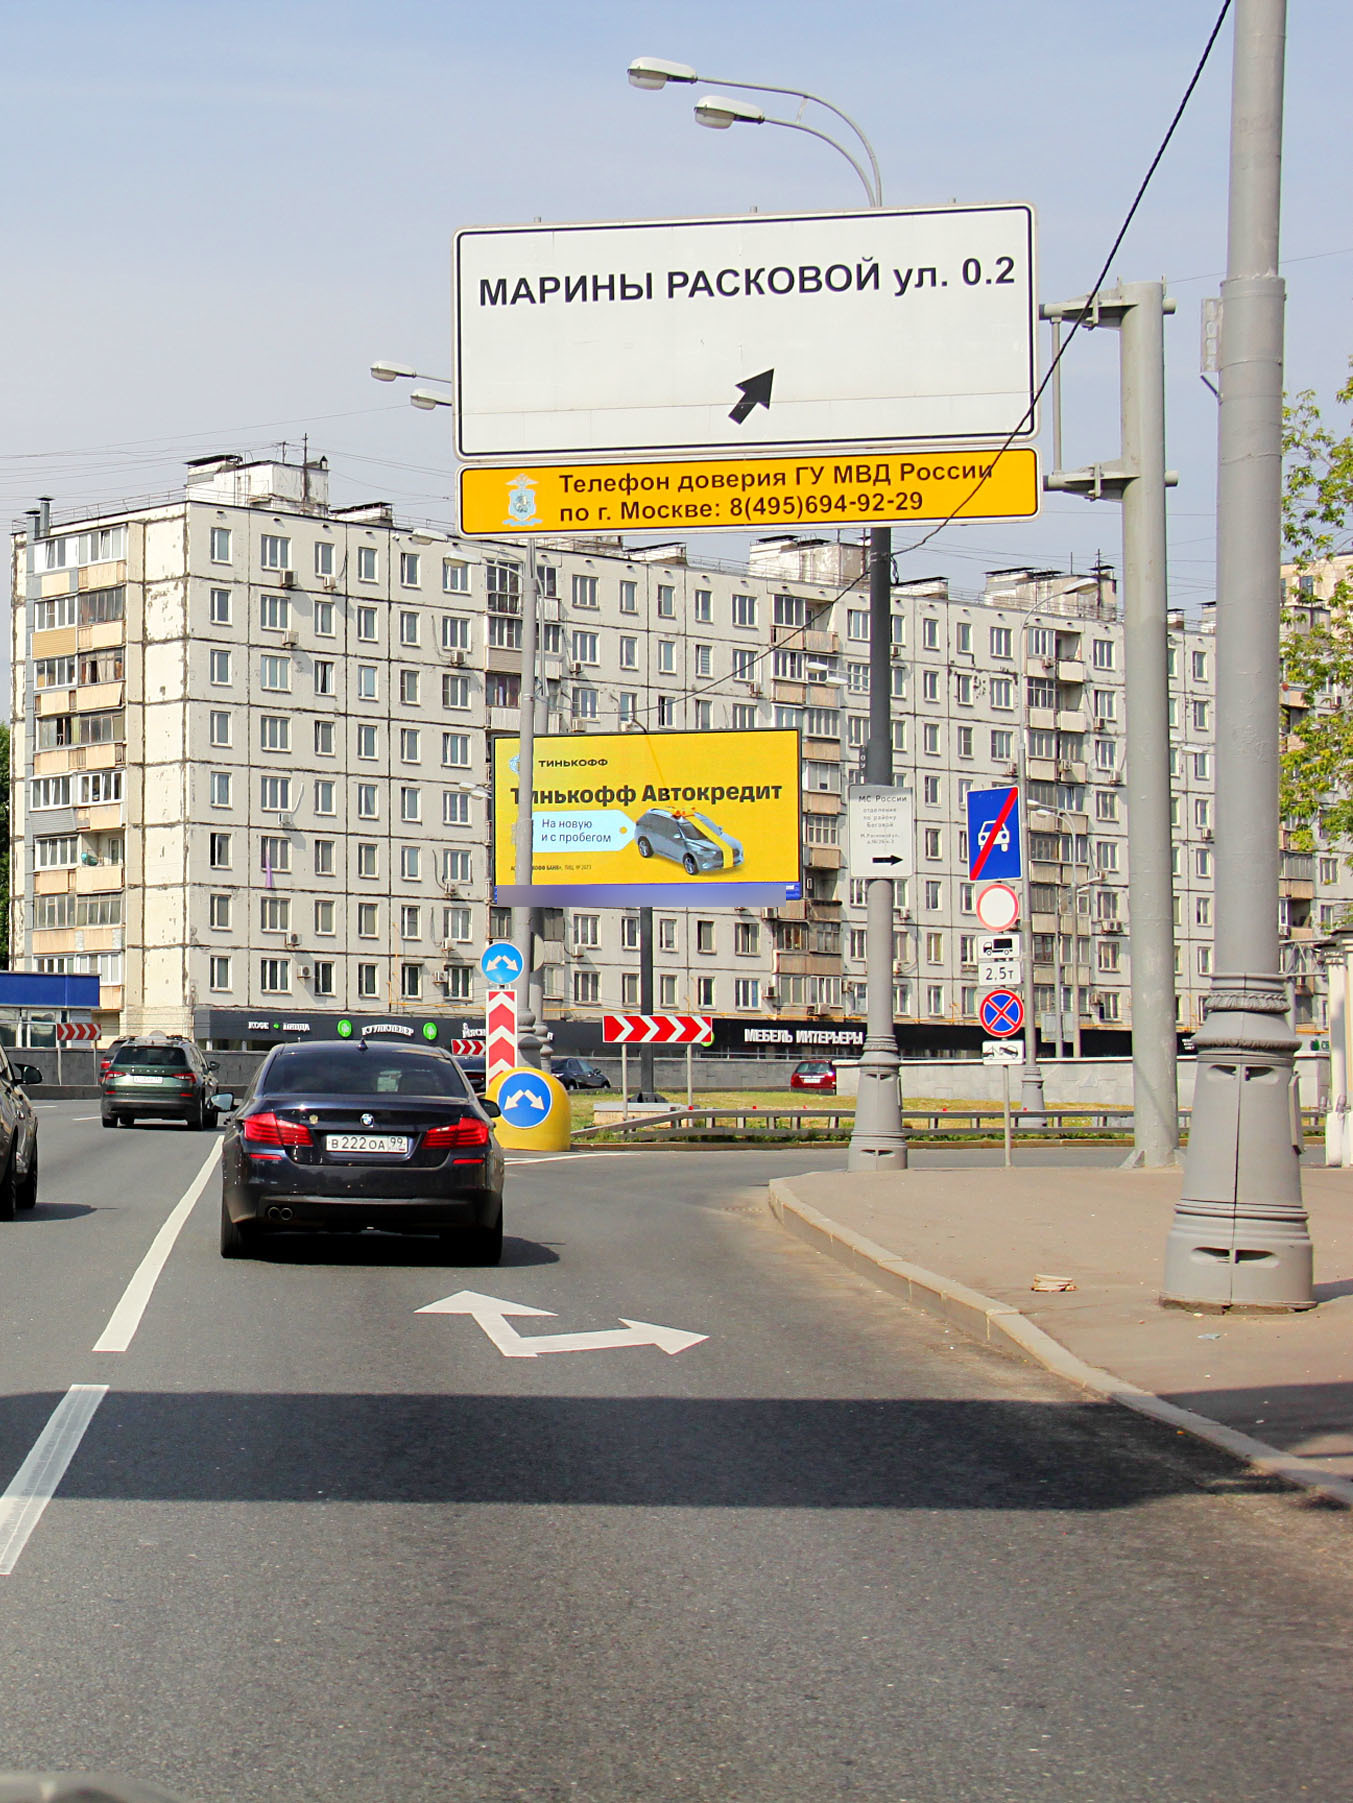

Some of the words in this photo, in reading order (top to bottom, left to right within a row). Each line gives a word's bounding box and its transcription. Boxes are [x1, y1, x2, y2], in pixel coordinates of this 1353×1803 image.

[480, 273, 653, 306] МАРИНЫ
[667, 256, 880, 298] РАСКОВОЙ
[894, 265, 949, 296] ул.
[962, 256, 1015, 286] 0.2
[560, 472, 669, 495] Телефон
[677, 472, 786, 493] доверия
[795, 466, 825, 486] ГУ
[833, 463, 891, 486] МВД
[900, 462, 994, 482] России
[560, 507, 590, 522] по
[598, 506, 612, 521] г.
[621, 501, 720, 521] Москве:
[730, 490, 923, 520] 8(495)694-92-29
[538, 758, 608, 768] ТИНЬКОФФ
[641, 784, 783, 806] Автокредит
[875, 794, 908, 803] России
[541, 818, 557, 829] На
[558, 820, 593, 831] новую
[541, 834, 548, 842] и
[550, 834, 557, 842] с
[559, 831, 613, 844] пробегом
[744, 1029, 793, 1043] МЕБЕЛЬ
[795, 1030, 864, 1045] ИНТЕРЬЕРЫ
